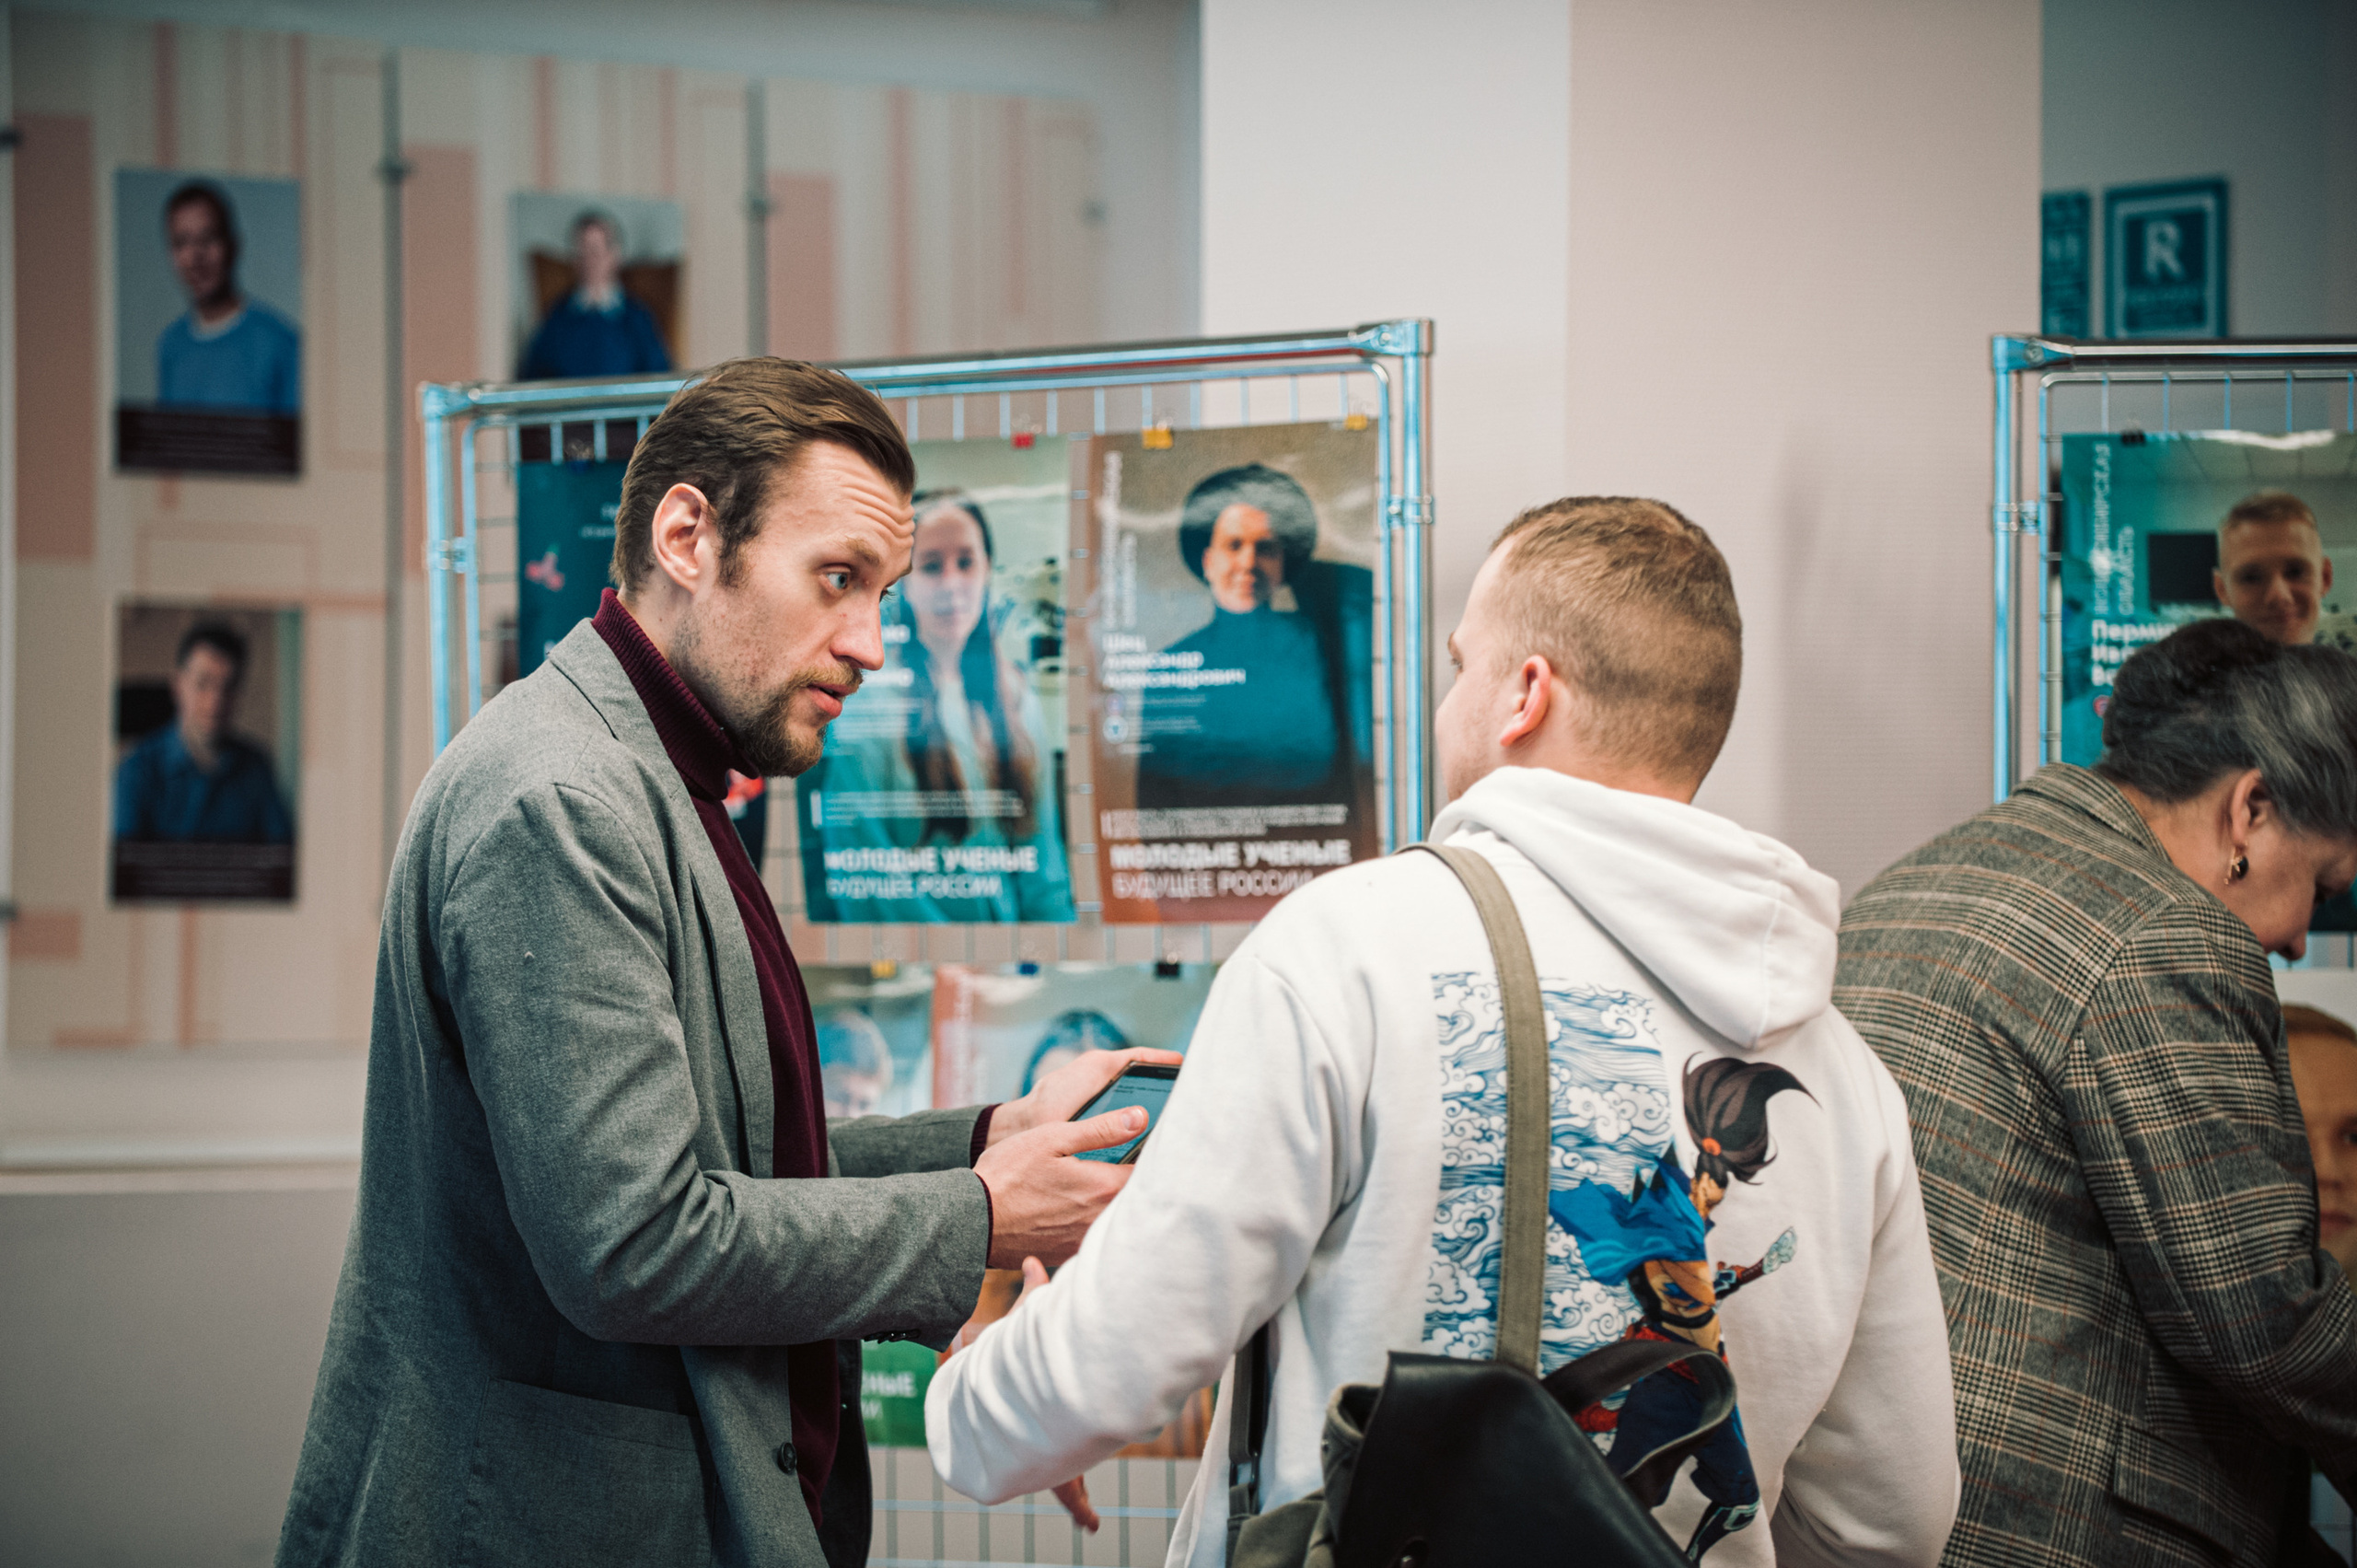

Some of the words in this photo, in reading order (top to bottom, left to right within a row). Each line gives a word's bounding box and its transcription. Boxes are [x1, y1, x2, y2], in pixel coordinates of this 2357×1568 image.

[2146, 220, 2182, 278] R
[824, 847, 937, 874] МОЛОДЫЕ
[941, 845, 1038, 873] УЧЕНЫЕ
[1109, 842, 1241, 870] МОЛОДЫЕ
[1243, 839, 1352, 867] УЧЕНЫЕ
[826, 875, 914, 900] БУДУЩЕЕ
[1111, 870, 1216, 901] БУДУЩЕЕ
